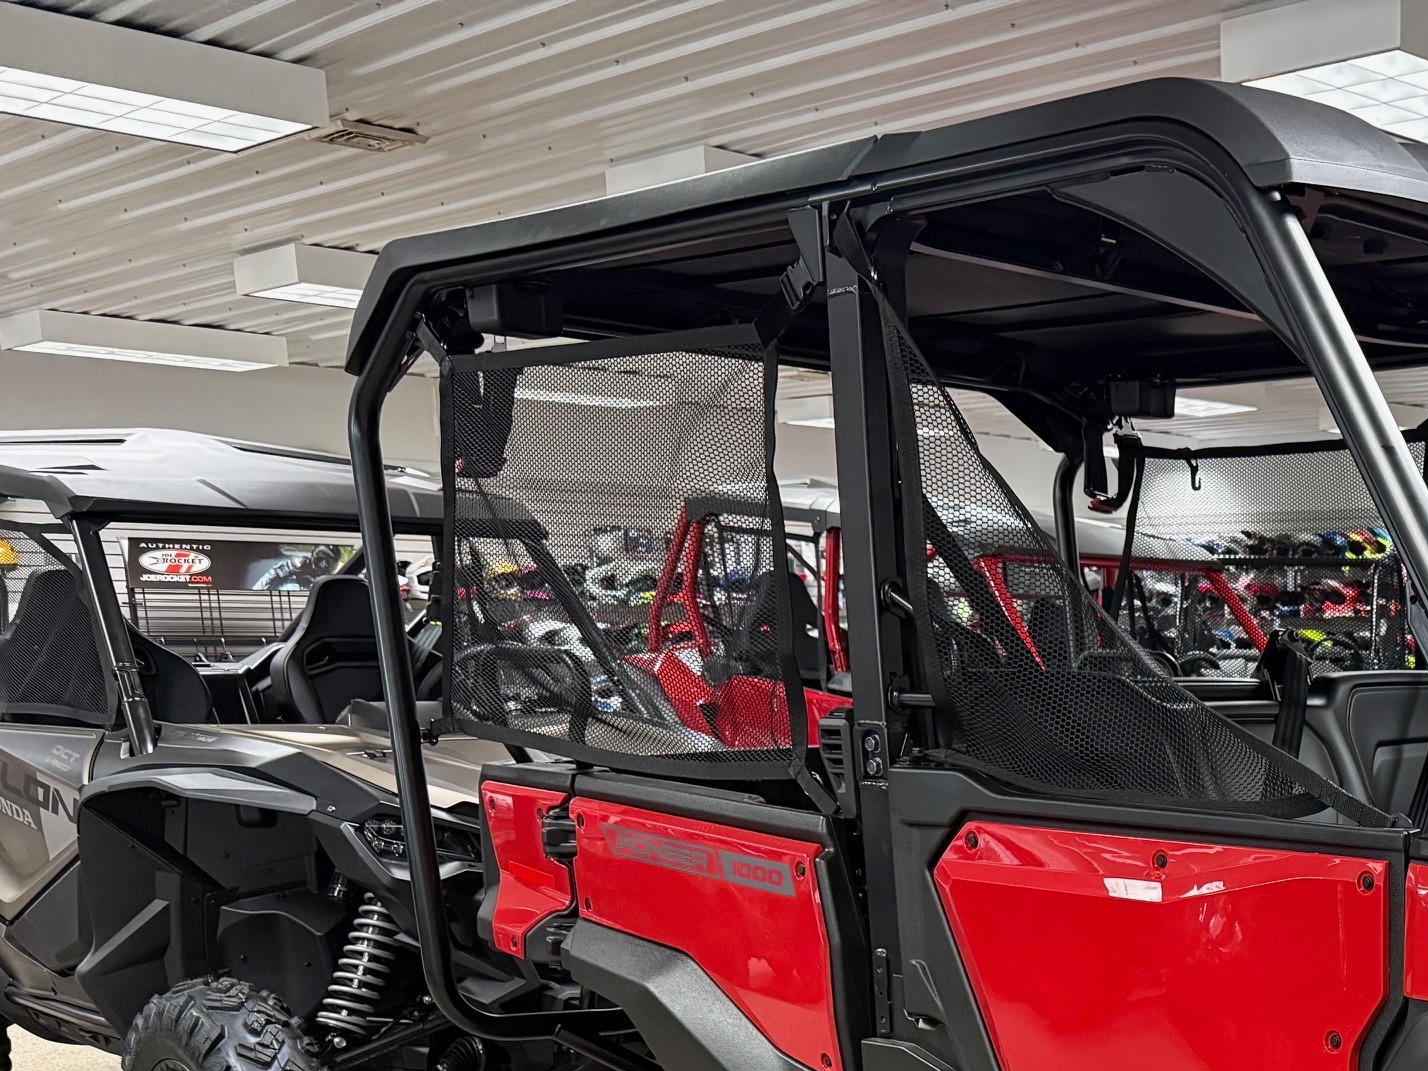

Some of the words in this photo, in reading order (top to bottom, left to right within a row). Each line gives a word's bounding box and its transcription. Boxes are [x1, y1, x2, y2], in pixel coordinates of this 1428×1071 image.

[139, 542, 212, 551] AUTHENTIC
[140, 574, 213, 583] JOEROCKET.COM
[614, 832, 710, 870] PIONEER
[731, 860, 784, 887] 1000
